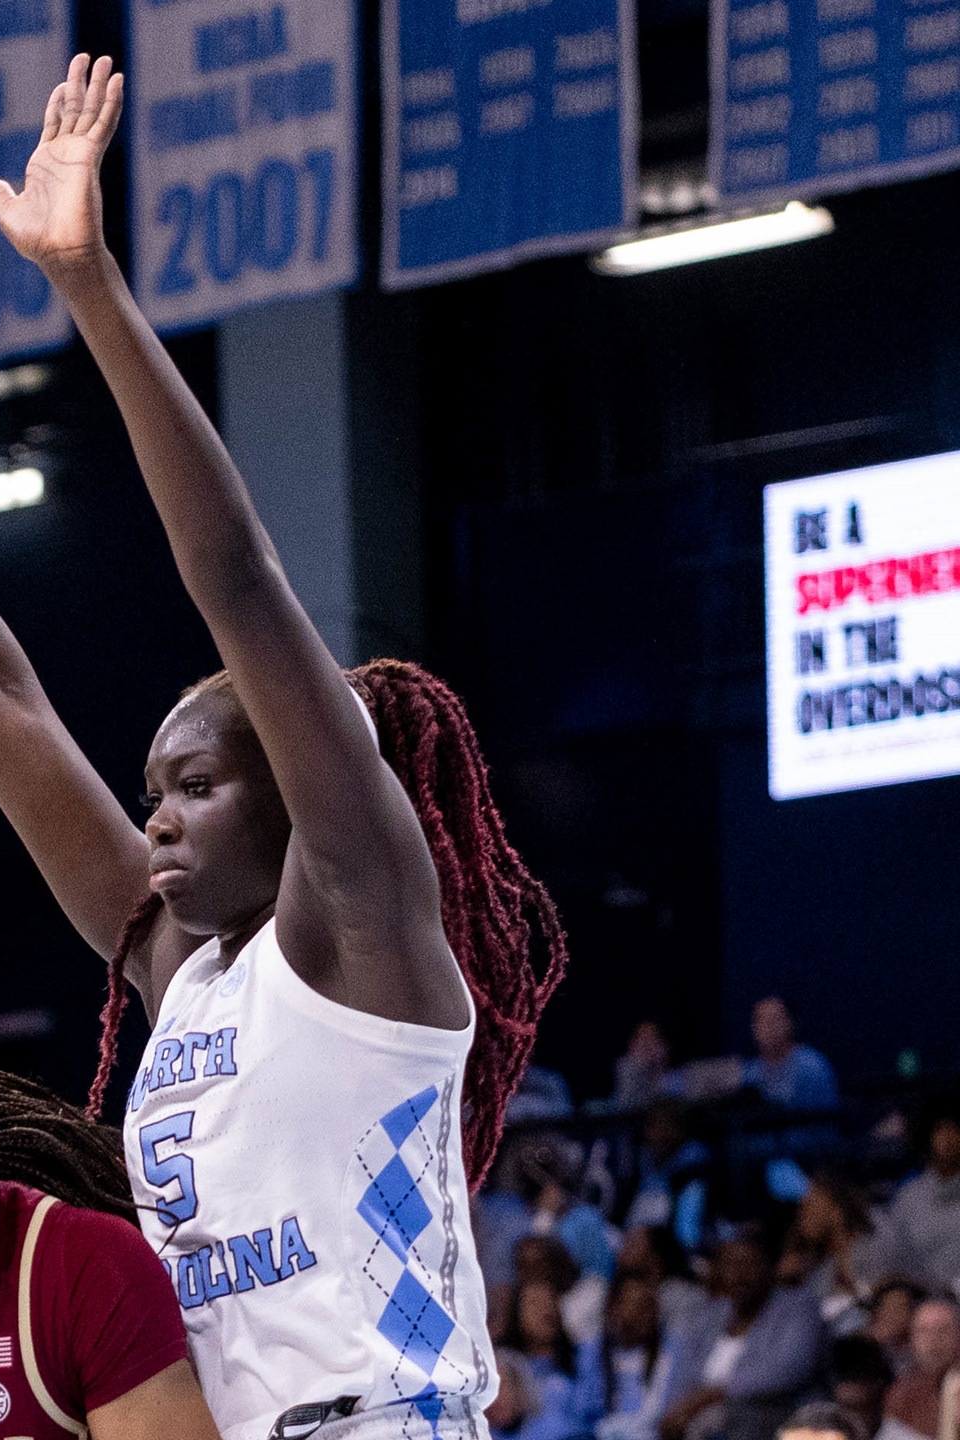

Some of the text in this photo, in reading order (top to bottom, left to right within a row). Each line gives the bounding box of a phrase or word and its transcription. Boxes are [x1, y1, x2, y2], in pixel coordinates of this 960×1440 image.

[155, 147, 336, 297] 2007
[796, 616, 897, 675] IN THE
[798, 672, 960, 733] OVERDOS
[140, 1111, 198, 1226] 5
